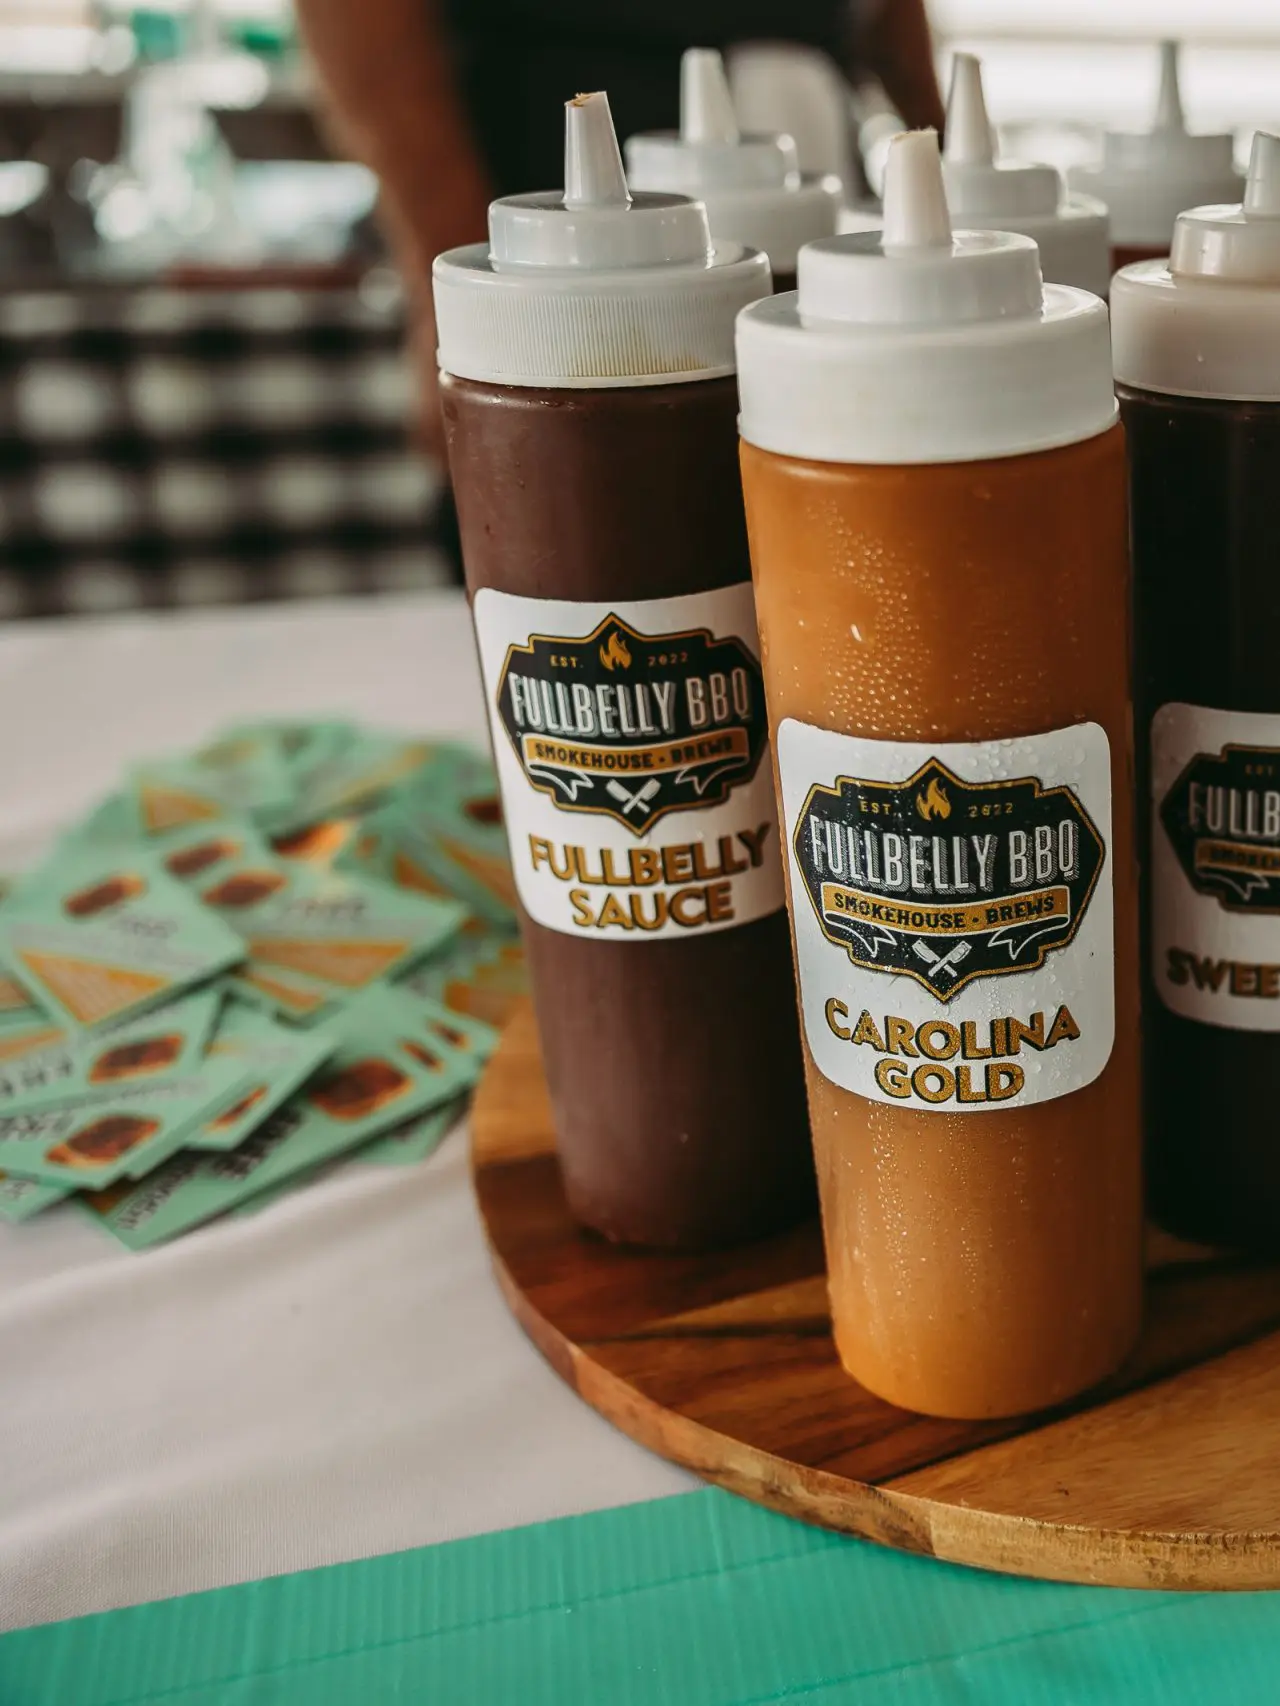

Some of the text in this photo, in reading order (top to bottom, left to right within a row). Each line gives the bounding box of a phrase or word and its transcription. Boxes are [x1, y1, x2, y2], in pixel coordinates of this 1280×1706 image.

[550, 651, 688, 668] EST. 2022
[508, 667, 751, 738] FULLBELLY BBQ
[535, 736, 732, 769] SMOKEHOUSE BREWS
[859, 801, 1014, 818] EST. 2022
[529, 822, 771, 886] FULLBELLY
[809, 815, 1079, 894] FULLBELLY BBQ
[569, 881, 736, 930] SAUCE
[834, 892, 1055, 928] SMOKEHOUSE BREWS
[825, 997, 1081, 1060] CAROLINA
[874, 1057, 1025, 1104] GOLD
